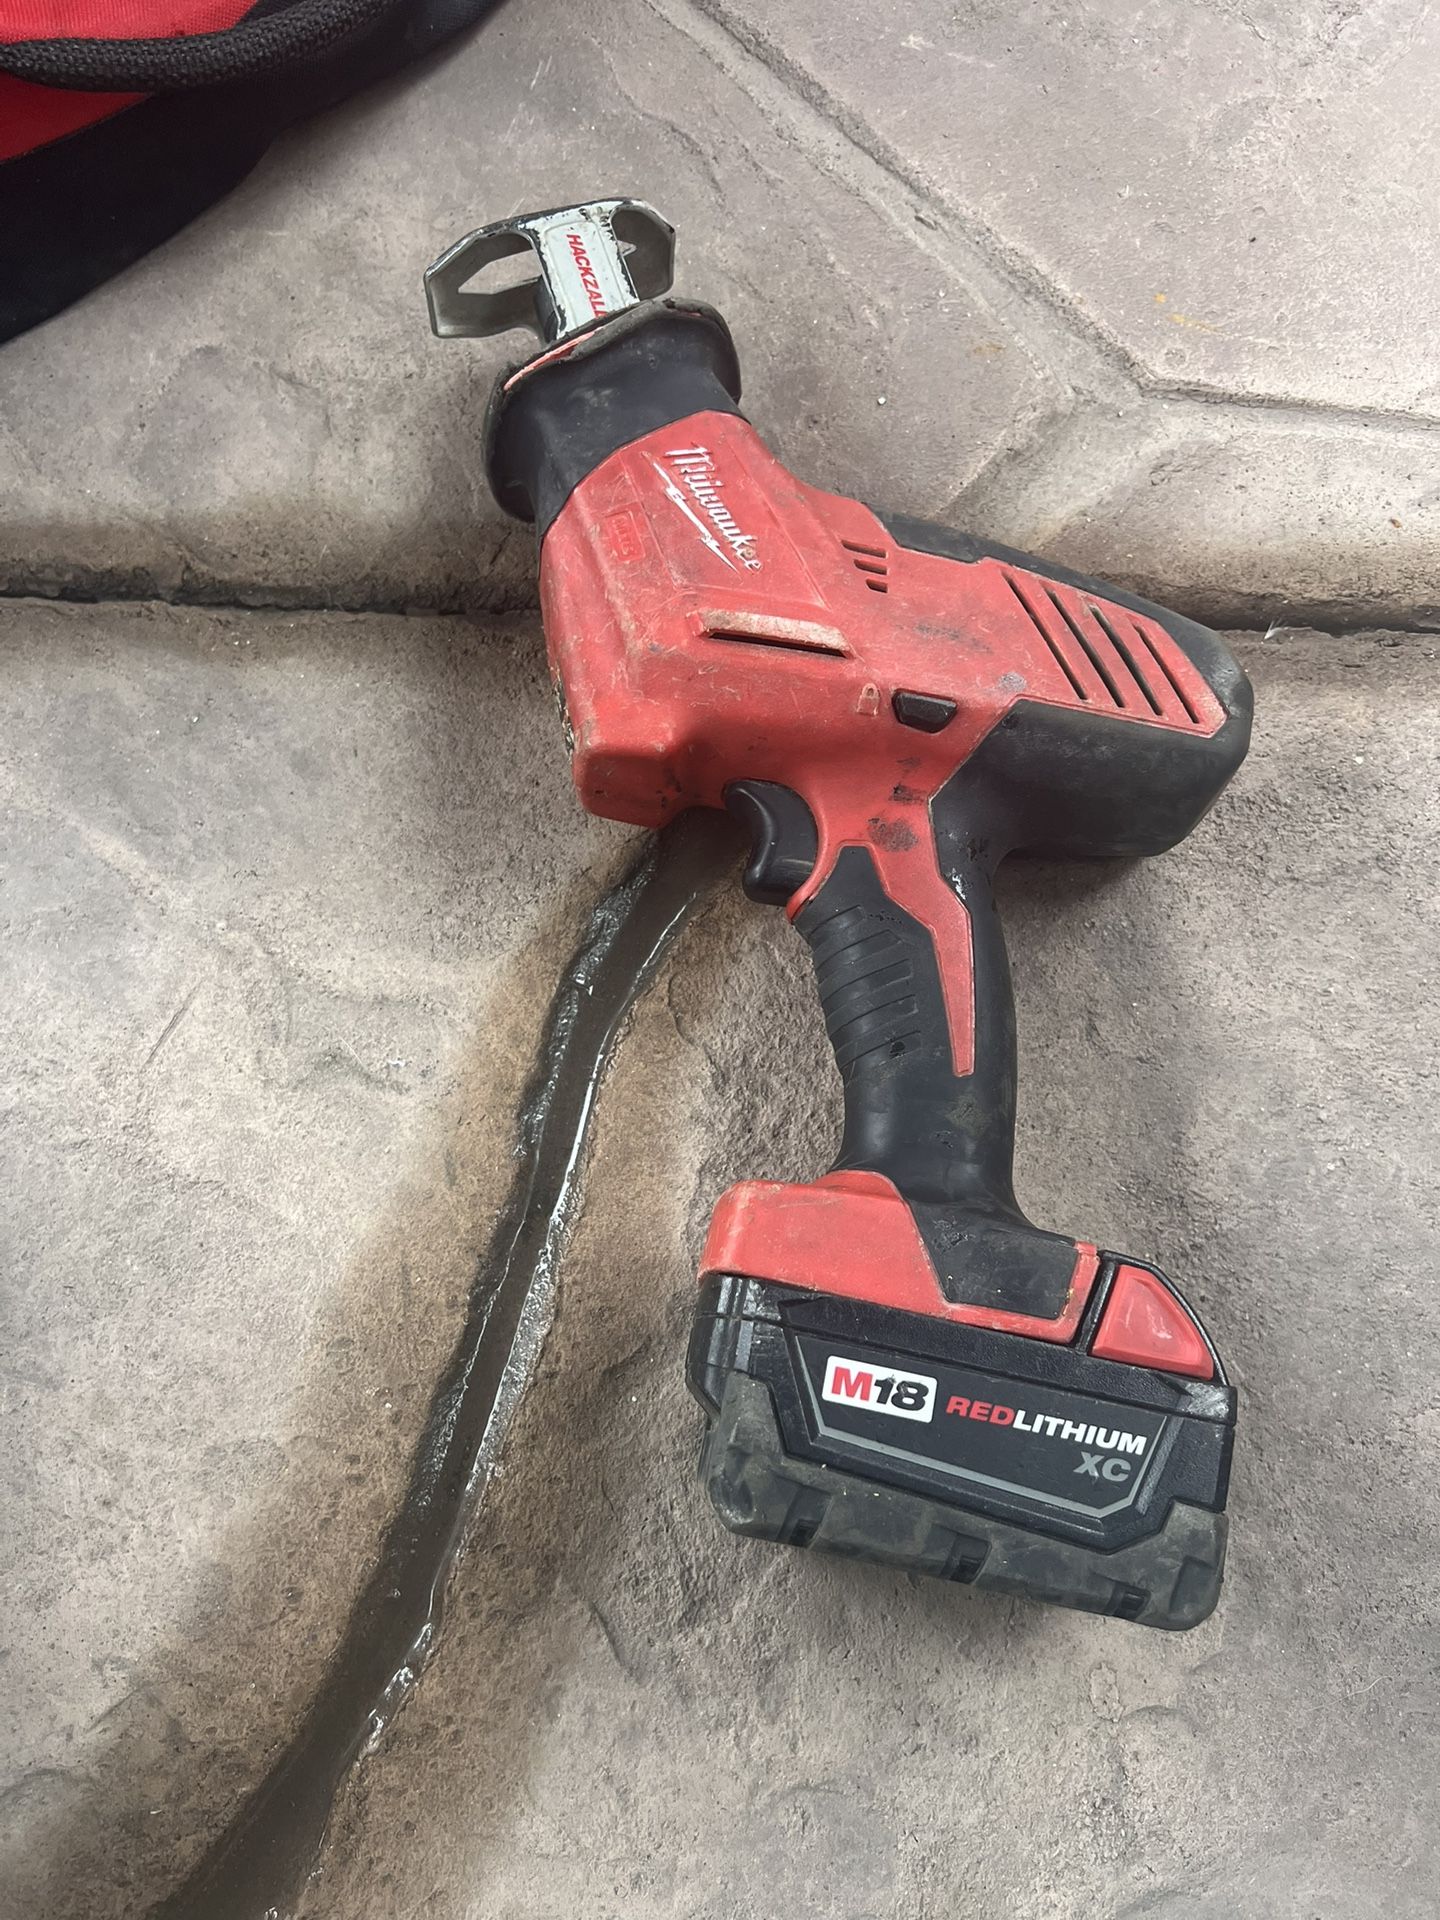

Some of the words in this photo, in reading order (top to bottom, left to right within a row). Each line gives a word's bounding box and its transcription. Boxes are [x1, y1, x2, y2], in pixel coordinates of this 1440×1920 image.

[567, 234, 608, 320] HACKZALL
[663, 445, 762, 571] Milwaukee
[831, 1366, 929, 1412] M18
[946, 1395, 1148, 1456] REDLITHIUM
[1073, 1452, 1132, 1482] XC
